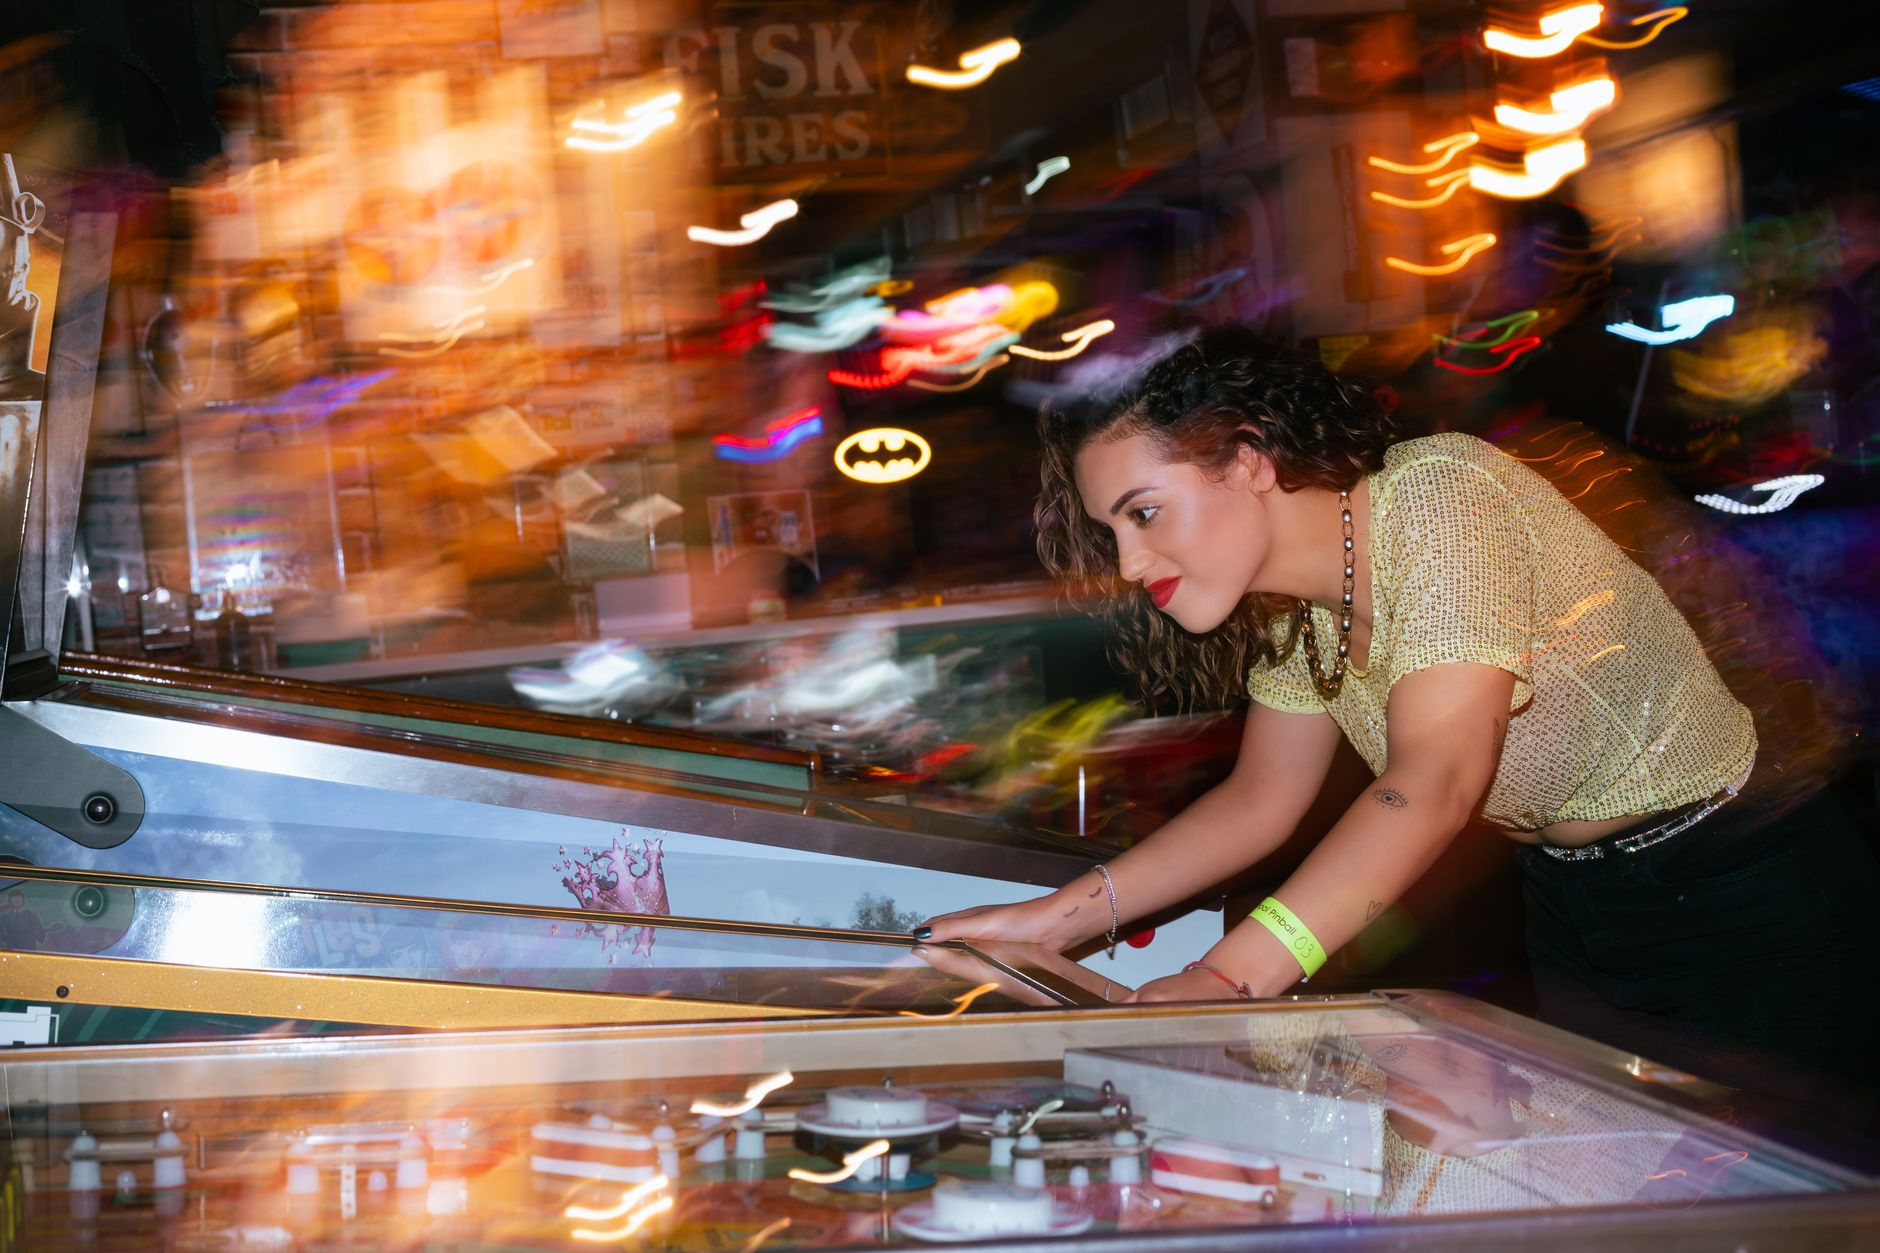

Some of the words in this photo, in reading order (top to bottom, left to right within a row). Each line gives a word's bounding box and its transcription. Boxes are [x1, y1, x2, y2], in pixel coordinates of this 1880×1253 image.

[661, 20, 875, 101] FISK
[689, 110, 871, 168] IRES
[1268, 908, 1297, 935] Pinball
[1294, 936, 1314, 958] 03
